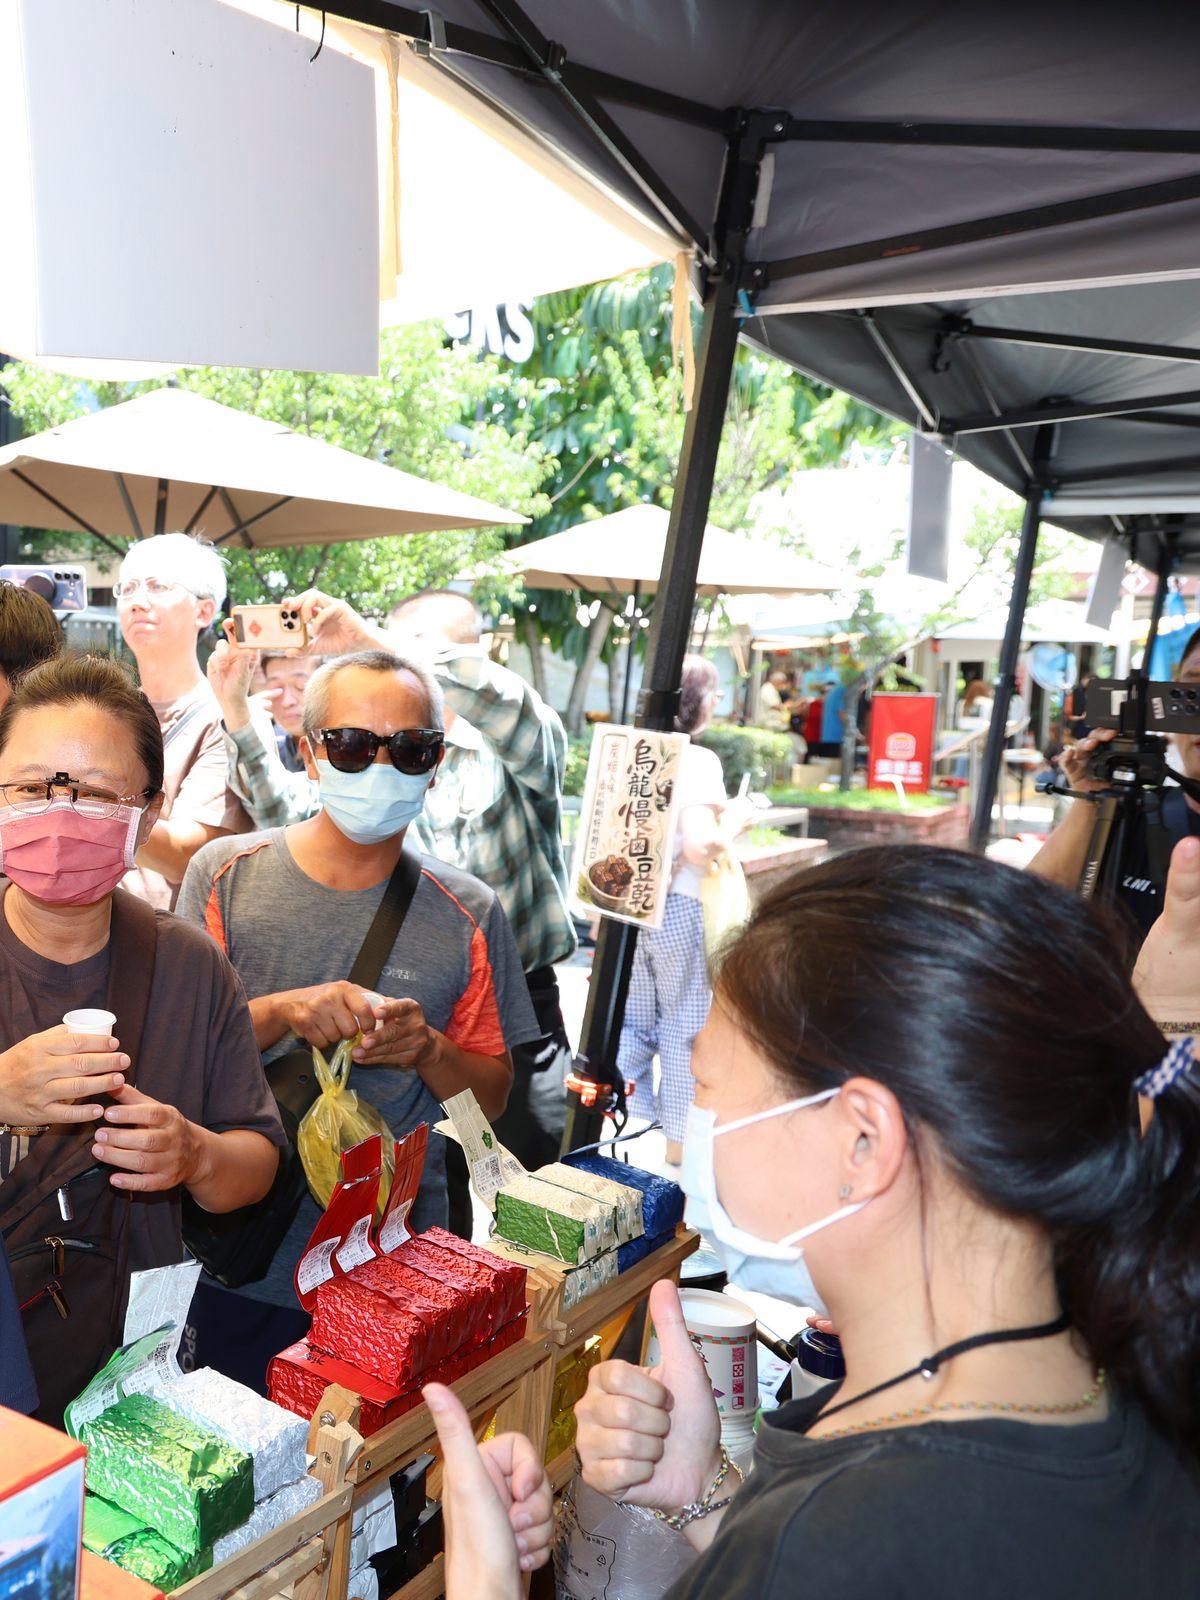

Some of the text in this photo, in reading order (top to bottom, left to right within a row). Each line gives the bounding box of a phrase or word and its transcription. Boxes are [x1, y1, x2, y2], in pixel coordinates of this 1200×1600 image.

[618, 738, 658, 911] 烏龍慢滷豆乾
